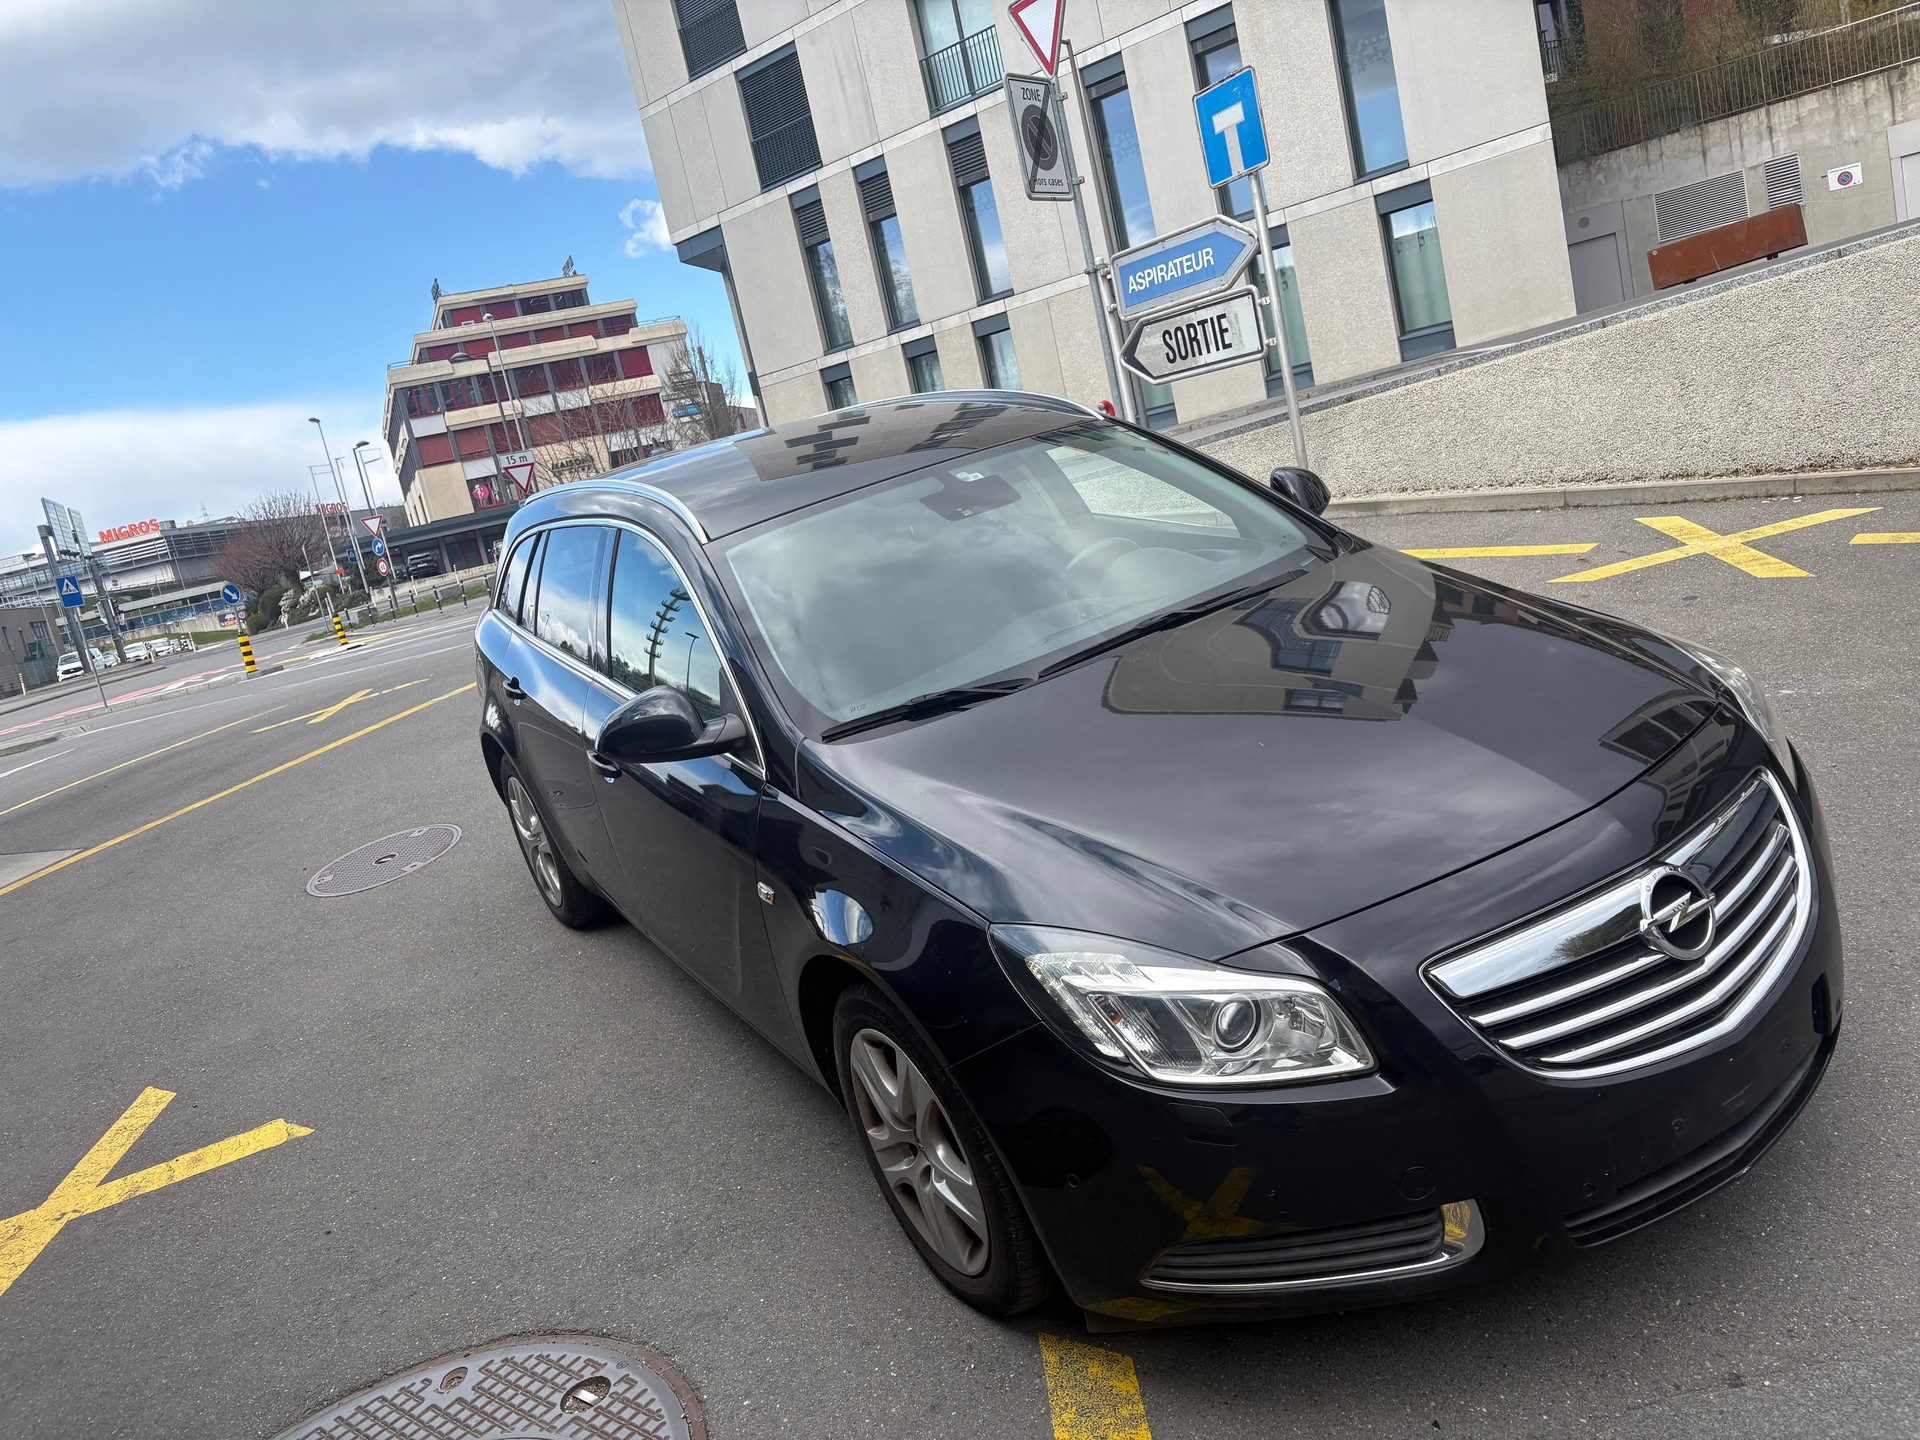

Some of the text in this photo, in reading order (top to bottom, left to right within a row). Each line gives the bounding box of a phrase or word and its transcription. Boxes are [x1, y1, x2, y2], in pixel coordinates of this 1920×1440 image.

[1021, 87, 1041, 101] ZONE
[1048, 178, 1063, 187] cases
[1128, 247, 1214, 294] ASPIRATEUR
[1162, 313, 1232, 364] SORTIE
[506, 455, 528, 465] 15 m
[98, 518, 160, 544] MIGROS
